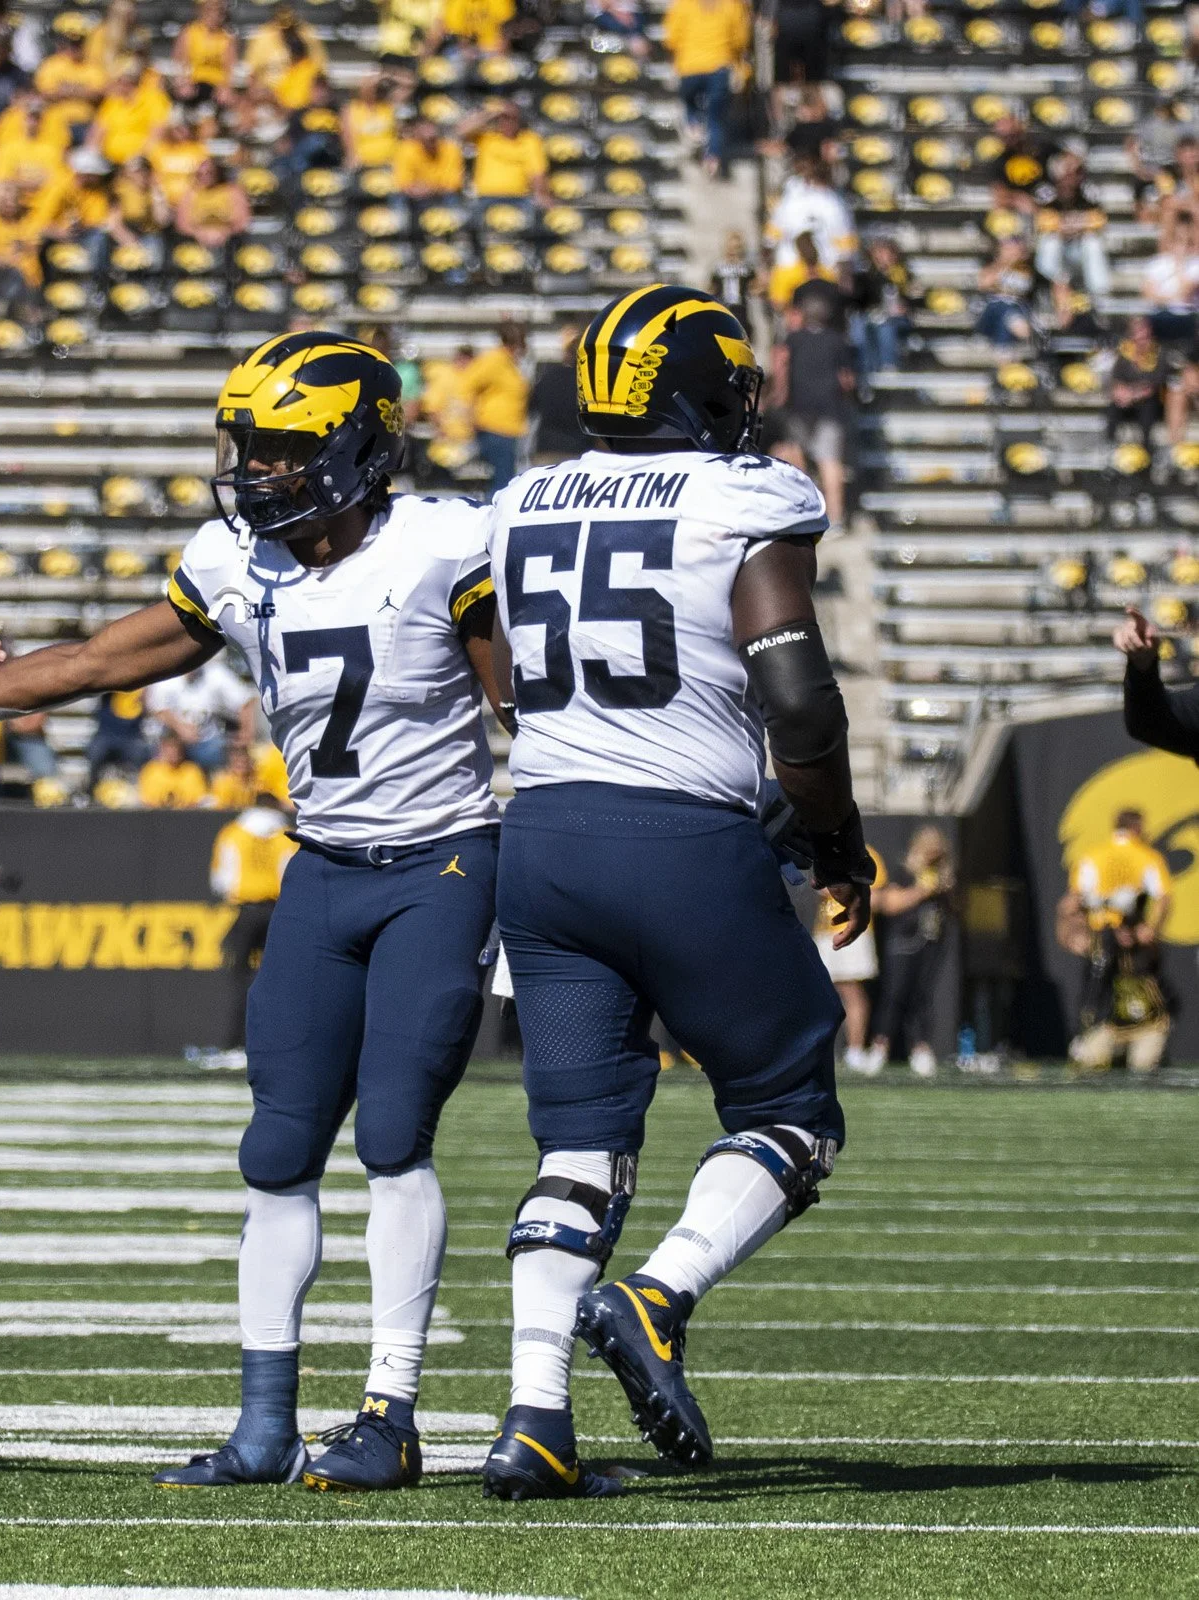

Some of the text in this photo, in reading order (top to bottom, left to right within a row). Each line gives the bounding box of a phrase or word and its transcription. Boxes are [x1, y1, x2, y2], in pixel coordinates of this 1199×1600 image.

[519, 473, 690, 514] OLUWATIMI
[505, 519, 682, 715] 55
[281, 624, 376, 779] 7
[361, 1396, 390, 1417] M
